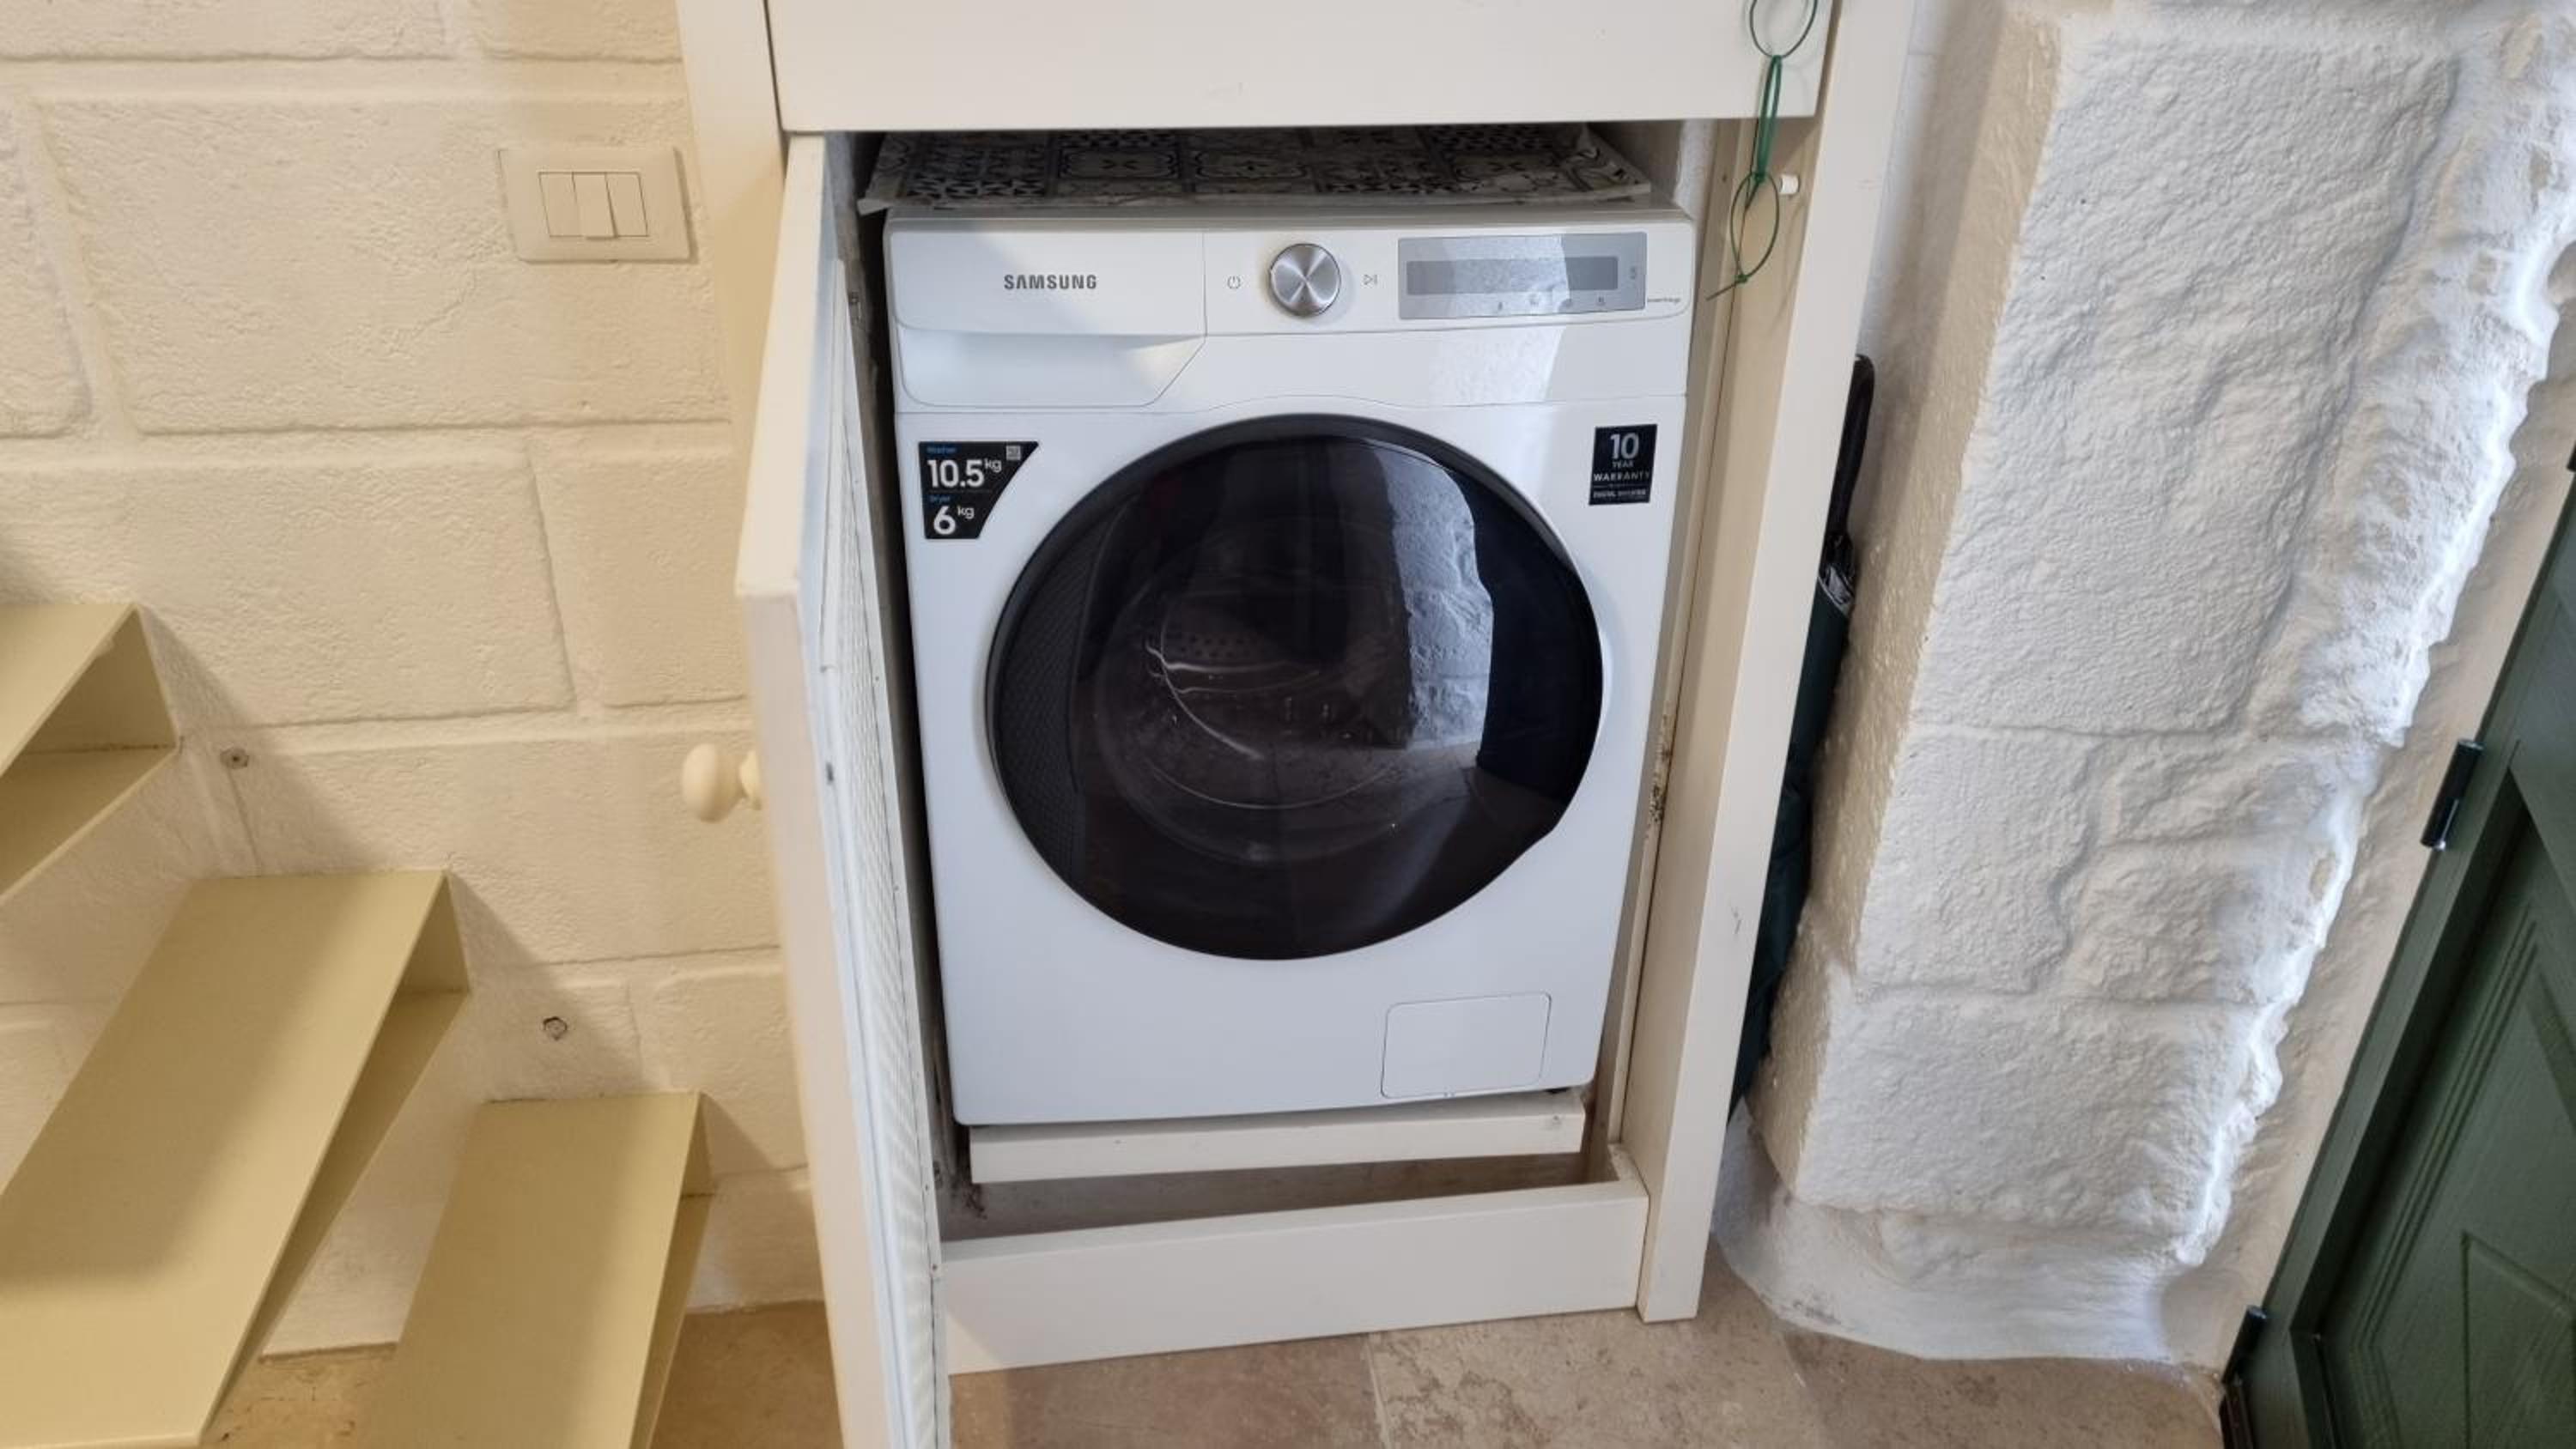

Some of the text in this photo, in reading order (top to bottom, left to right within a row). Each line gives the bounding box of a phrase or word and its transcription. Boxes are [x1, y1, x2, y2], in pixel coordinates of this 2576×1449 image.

[1004, 274, 1097, 289] SAMSUNG
[1610, 433, 1639, 459] 10
[927, 458, 1002, 488] 10.5 kg
[1593, 470, 1649, 481] WARRANTY
[933, 505, 975, 535] 6 kg
